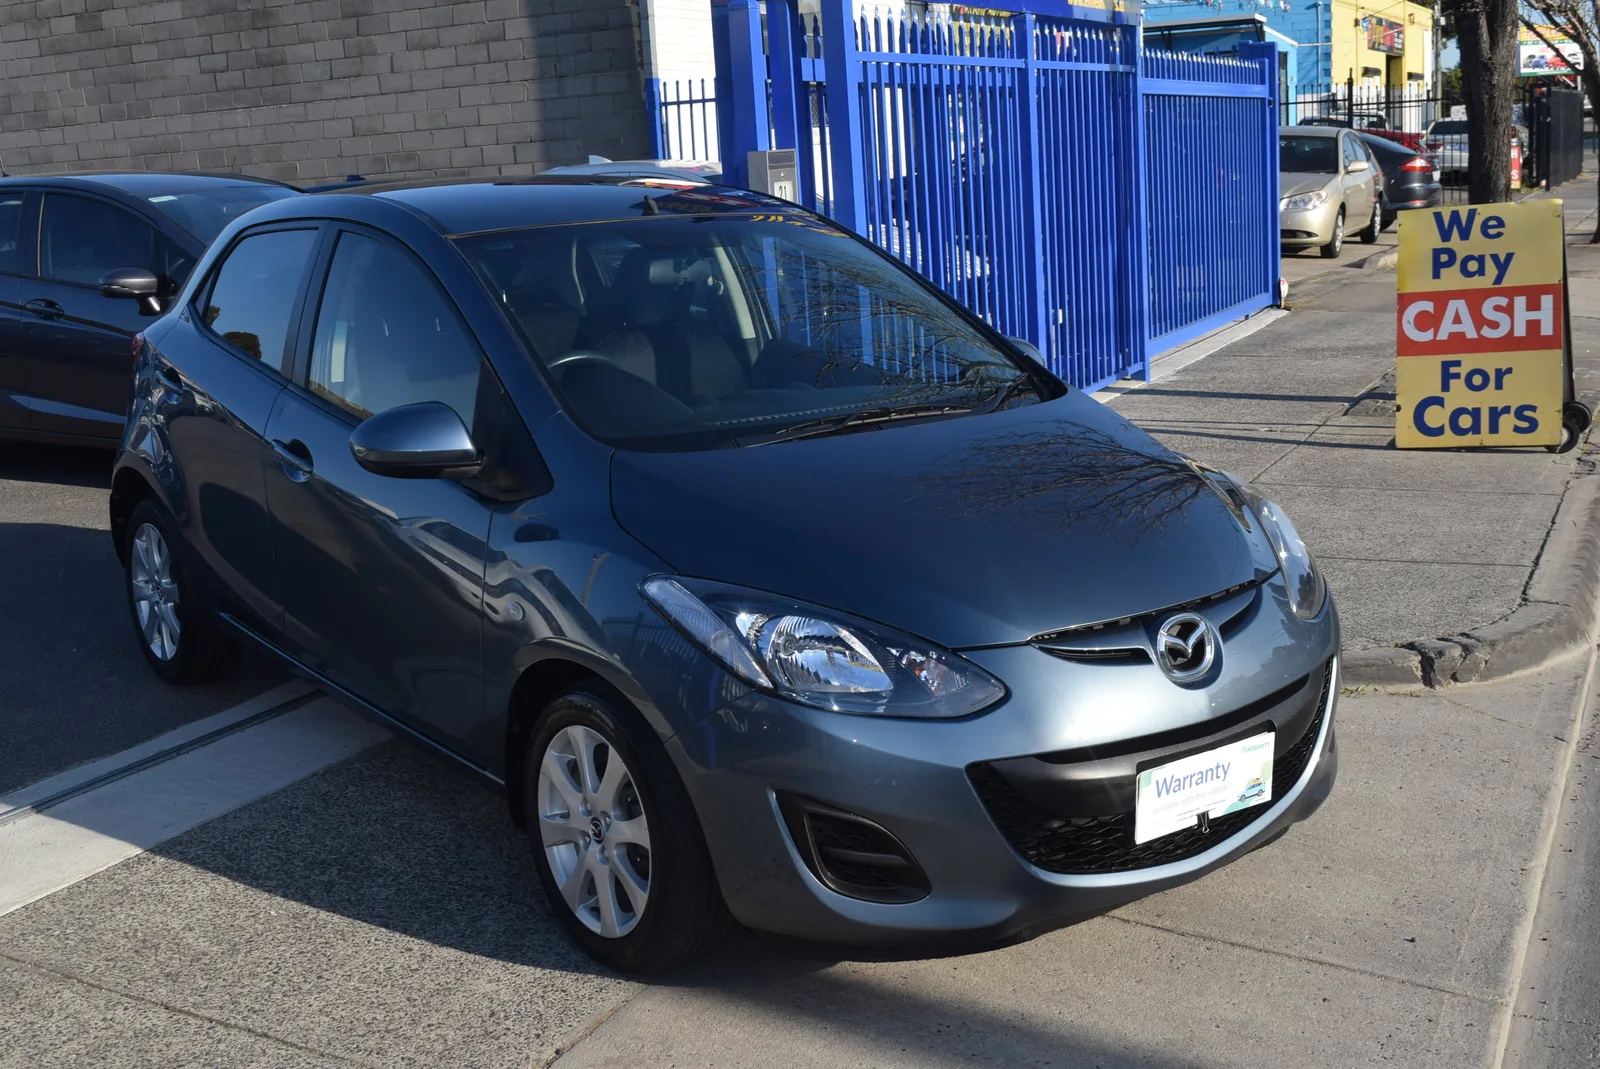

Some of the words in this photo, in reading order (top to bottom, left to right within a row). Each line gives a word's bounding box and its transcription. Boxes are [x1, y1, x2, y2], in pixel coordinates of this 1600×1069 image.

[1433, 208, 1506, 242] We
[1432, 247, 1515, 285] Pay
[1402, 294, 1554, 342] CASH
[1440, 360, 1513, 392] For
[1413, 396, 1539, 437] Cars
[1156, 761, 1231, 798] Warranty
